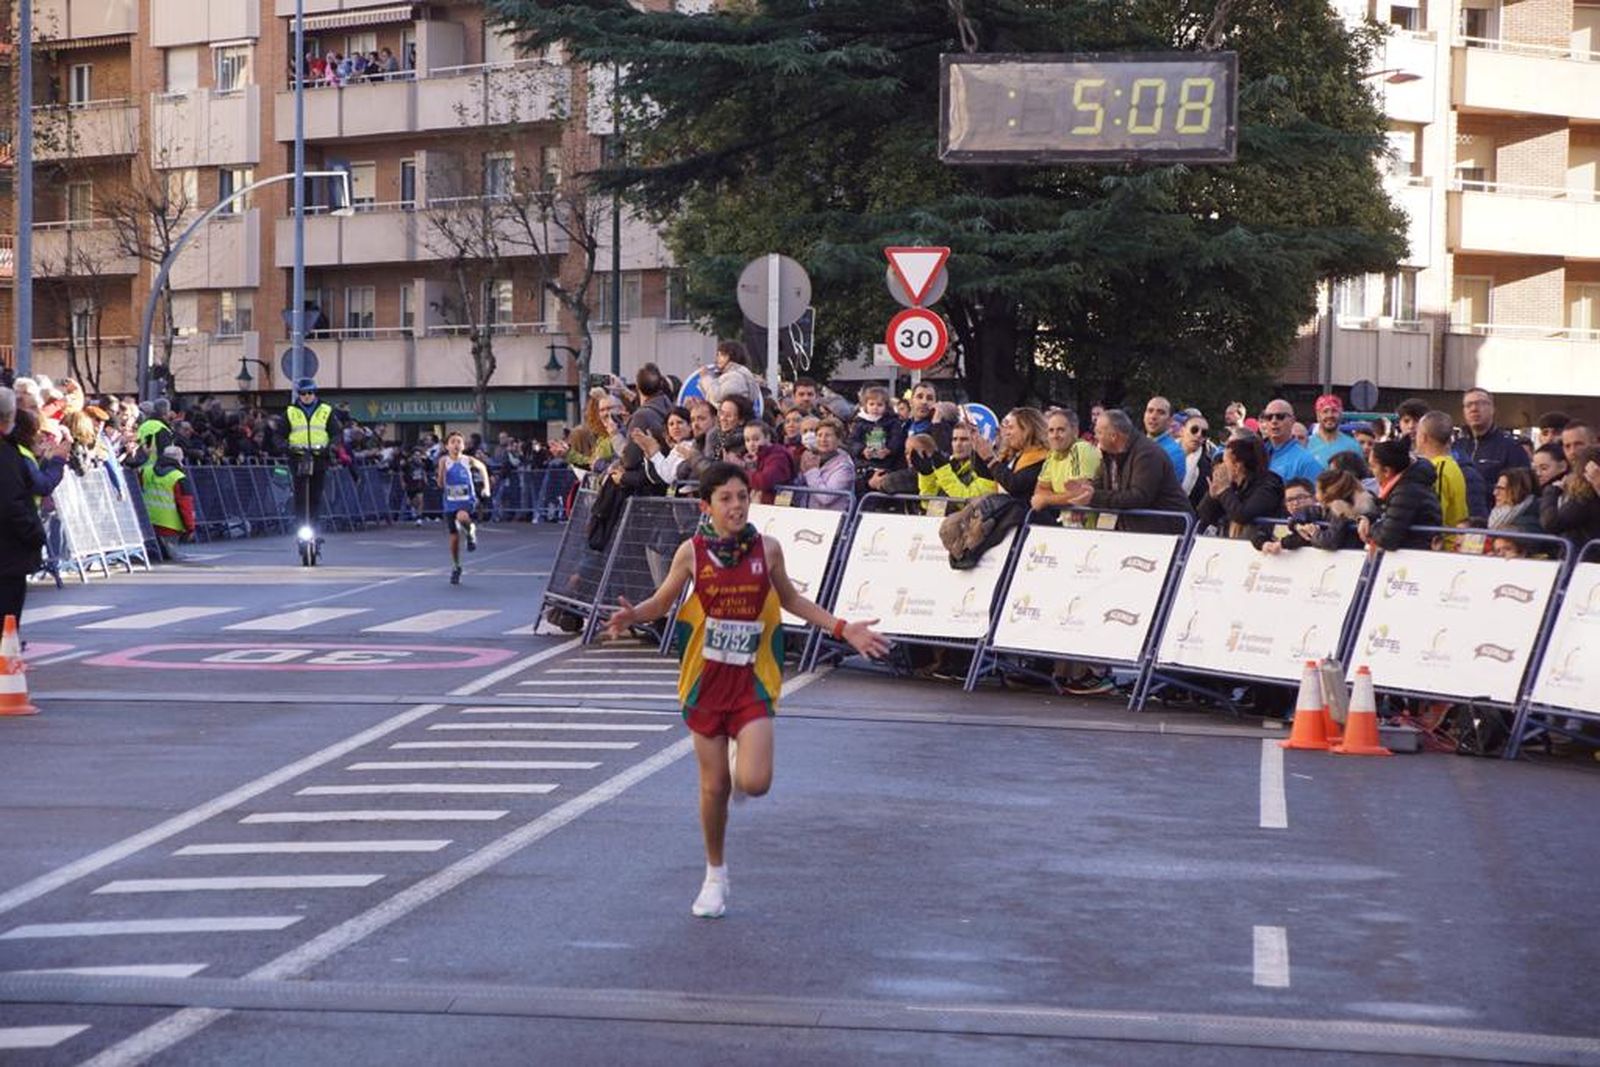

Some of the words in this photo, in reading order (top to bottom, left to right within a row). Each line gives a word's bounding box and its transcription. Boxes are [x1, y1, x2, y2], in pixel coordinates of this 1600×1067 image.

[1072, 78, 1215, 134] 5:08
[900, 329, 933, 349] 30
[711, 630, 751, 652] 5752
